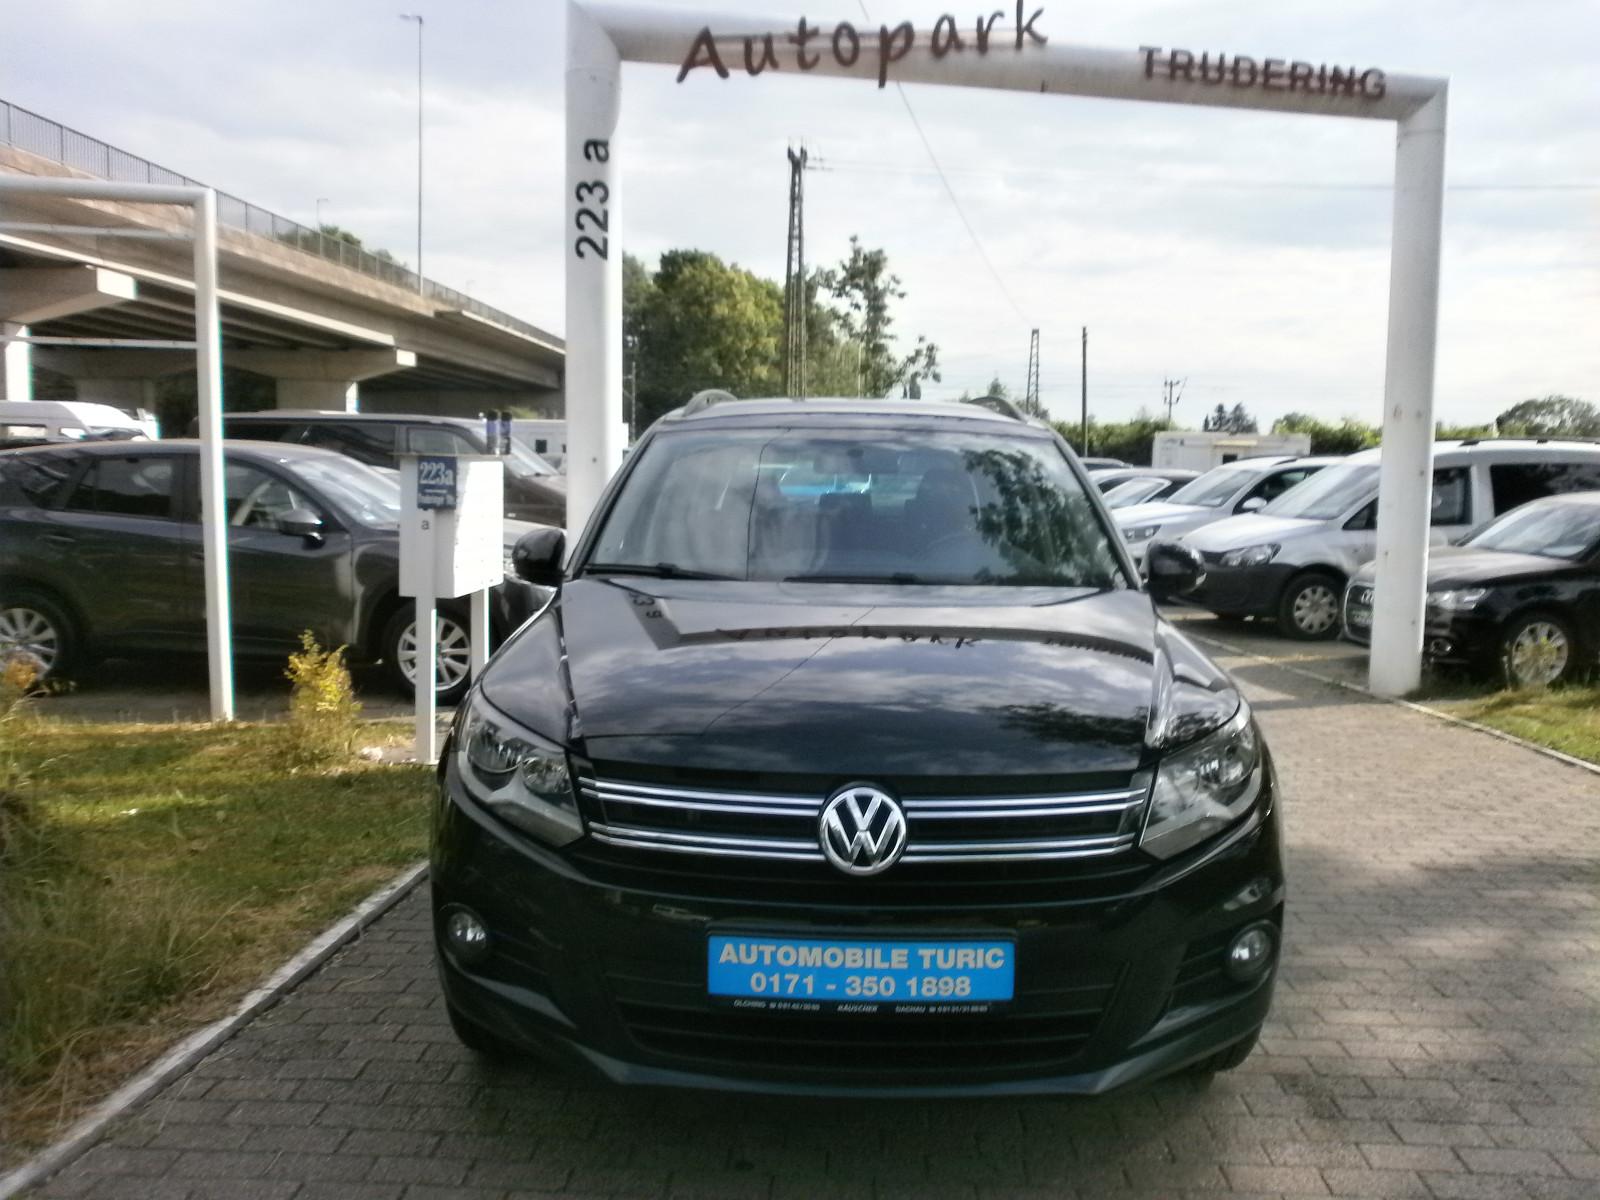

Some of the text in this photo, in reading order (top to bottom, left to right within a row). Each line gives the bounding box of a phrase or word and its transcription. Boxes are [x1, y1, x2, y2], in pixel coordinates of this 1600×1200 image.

[677, 0, 1048, 88] Autopark
[1138, 45, 1387, 100] TRUDERING
[575, 138, 609, 260] 223 a
[419, 461, 454, 486] 223a
[421, 520, 430, 530] a
[822, 788, 905, 875] VW
[719, 942, 1006, 970] AUTOMOBILE TURIC
[750, 972, 815, 995] 0171
[845, 975, 896, 997] 350
[906, 976, 972, 997] 1898
